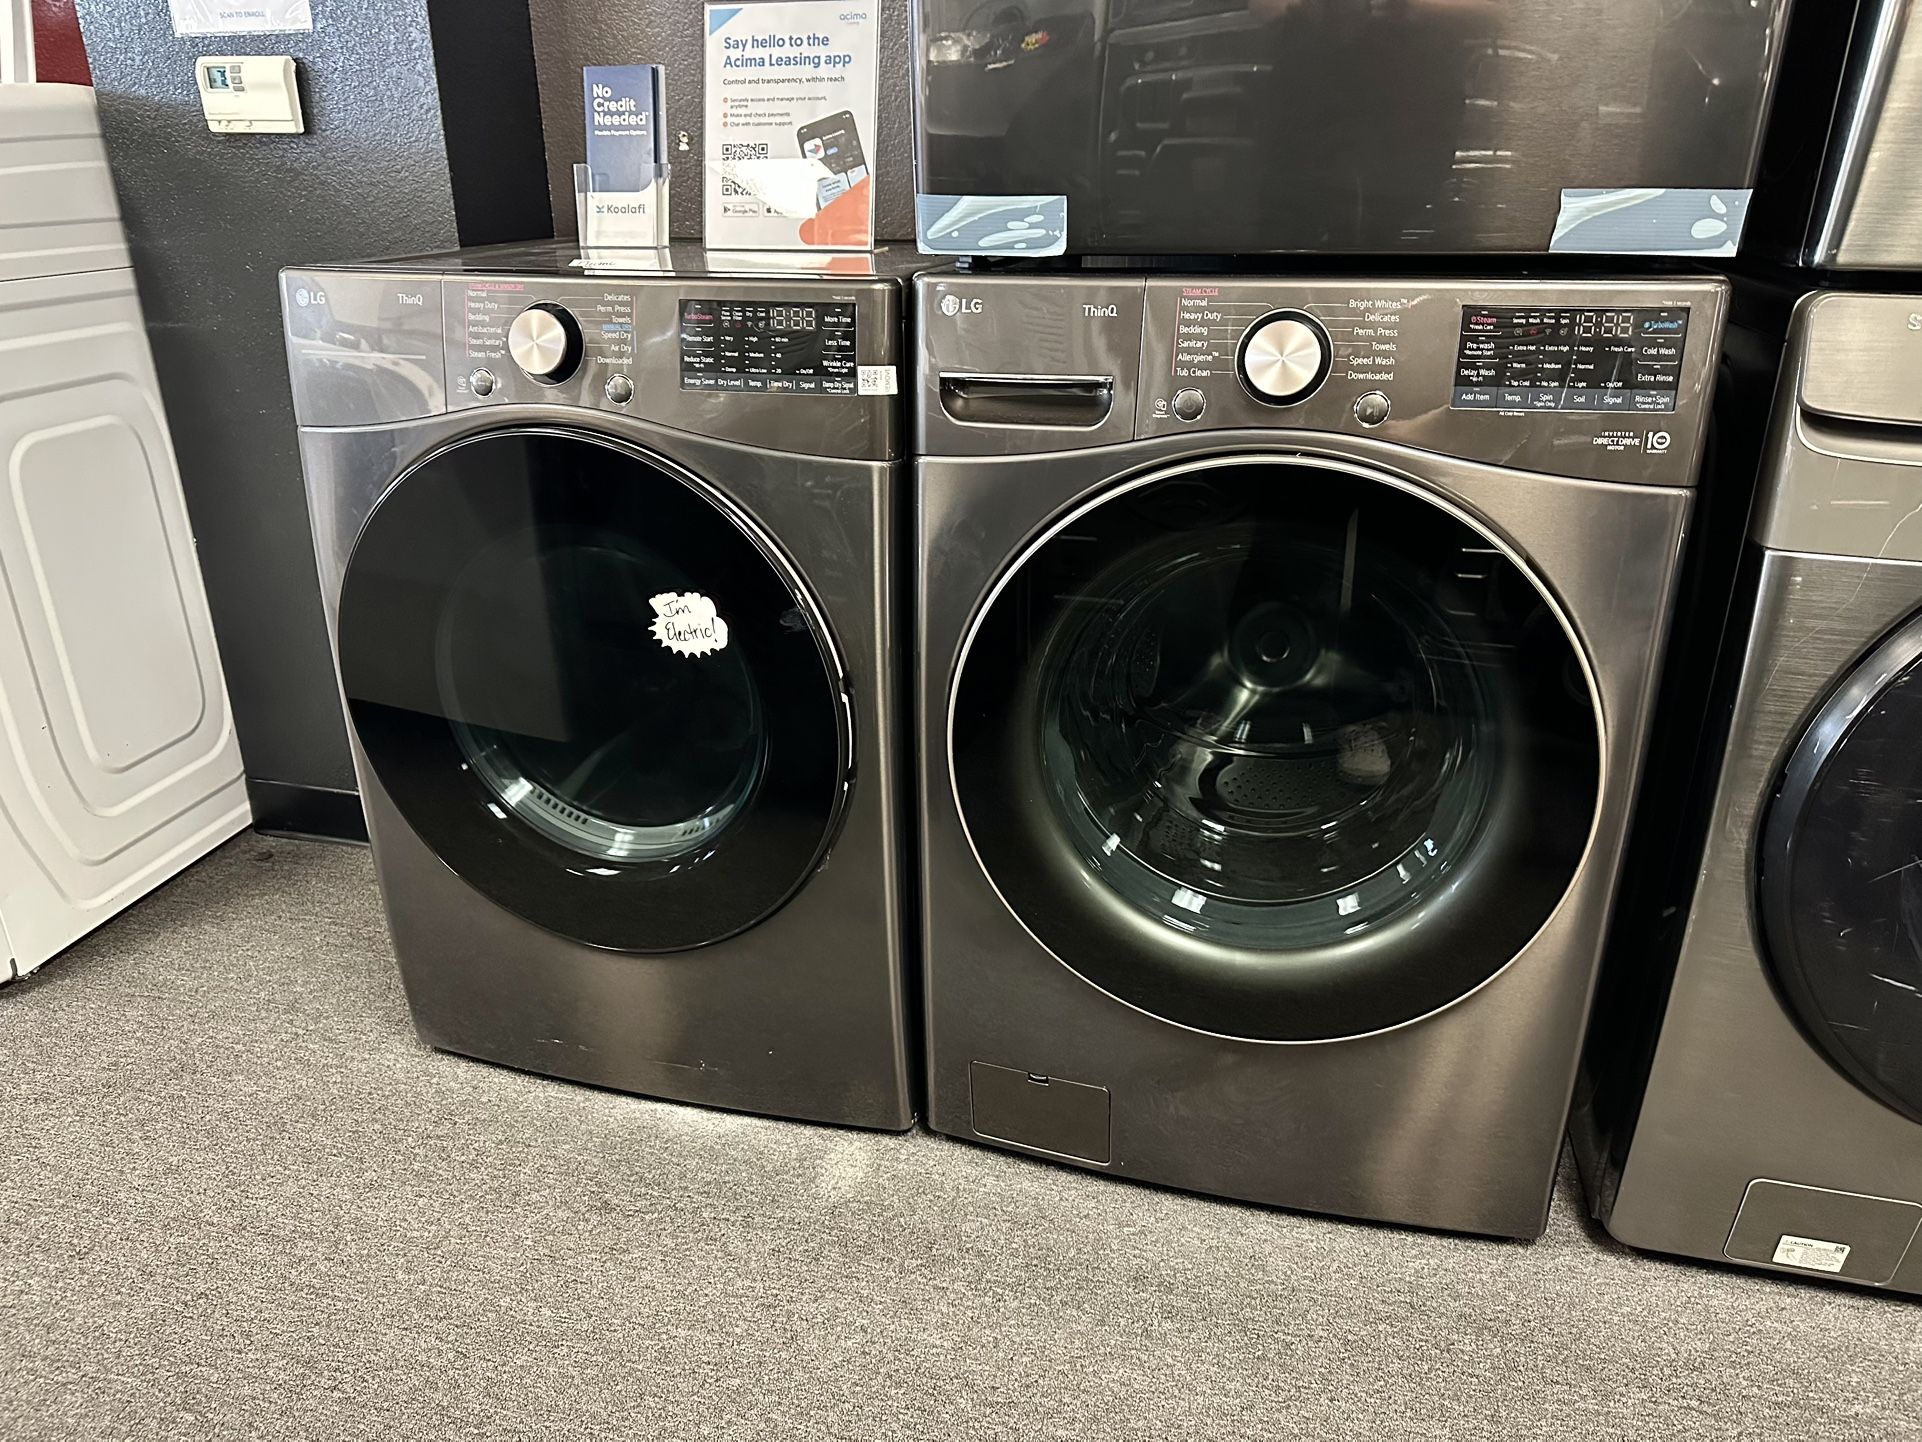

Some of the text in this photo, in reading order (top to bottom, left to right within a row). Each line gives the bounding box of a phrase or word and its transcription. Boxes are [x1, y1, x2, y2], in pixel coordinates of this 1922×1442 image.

[839, 11, 867, 21] acima
[724, 33, 830, 52] Say hello to the
[723, 52, 852, 69] Acima Leasing app
[723, 75, 845, 87] Control and transparency, within reach
[592, 84, 612, 98] No
[593, 98, 636, 112] Credit
[606, 203, 646, 214] Koalafi
[603, 293, 631, 301] Delicates
[1182, 288, 1219, 296] STEAM CYCLE
[397, 293, 423, 306] ThinQ
[1181, 298, 1208, 306] Normal
[1348, 299, 1373, 310] Bright
[468, 301, 498, 311] Heavy Duty
[596, 304, 631, 313] Perm. Press
[1082, 304, 1118, 317] ThinQ
[611, 315, 631, 324] Towels
[824, 315, 838, 323] More
[1180, 311, 1222, 321] Heavy Duty
[1364, 313, 1400, 322] Delicates
[1478, 316, 1497, 324] Steam
[1179, 325, 1208, 336] Bedding
[1353, 326, 1399, 337] Perm. Press
[601, 331, 632, 341] Speed Dry
[611, 344, 632, 354] Air Dry
[1178, 338, 1208, 350] Sanitary
[1371, 341, 1397, 351] Towels
[1642, 346, 1676, 355] Cold Wash
[596, 355, 633, 365] Downloaded
[1349, 355, 1395, 366] Speed Wash
[1176, 367, 1211, 377] Tub Clean
[1347, 371, 1394, 381] Downloaded
[1460, 368, 1496, 377] Delay Wash
[1637, 374, 1674, 382] Extra Rinse
[799, 381, 816, 389] Signal
[1461, 393, 1474, 401] Add
[1504, 394, 1521, 403] Temp.
[1539, 394, 1553, 402] Spin
[1573, 395, 1586, 403] Soil
[1603, 396, 1623, 405] Signal
[1592, 437, 1641, 446] DIRECT DRIVE
[663, 599, 692, 618] I'm
[665, 617, 718, 643] Electric!
